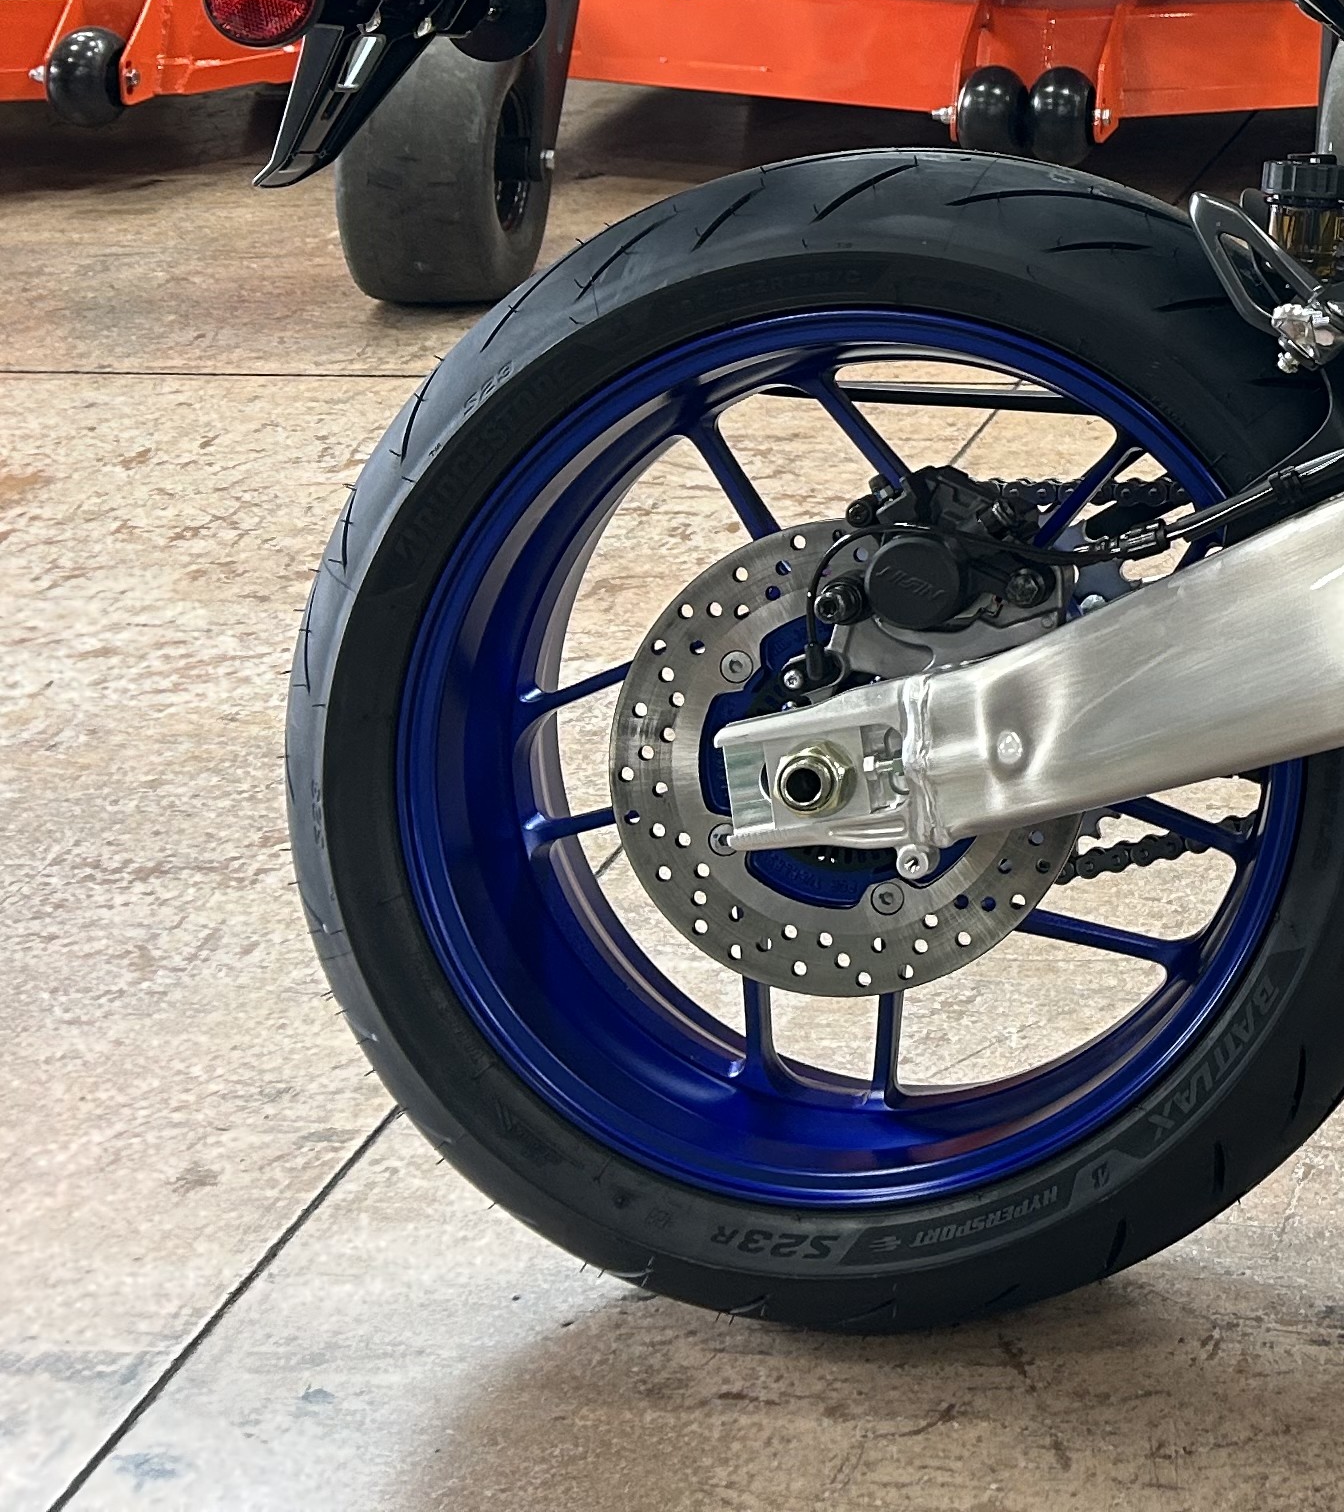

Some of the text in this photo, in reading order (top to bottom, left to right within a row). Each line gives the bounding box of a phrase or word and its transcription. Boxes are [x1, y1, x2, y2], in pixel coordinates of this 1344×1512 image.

[1148, 975, 1281, 1142] BATTLAX
[711, 1224, 840, 1260] S23R
[908, 1186, 1058, 1250] HYPERSPORT
